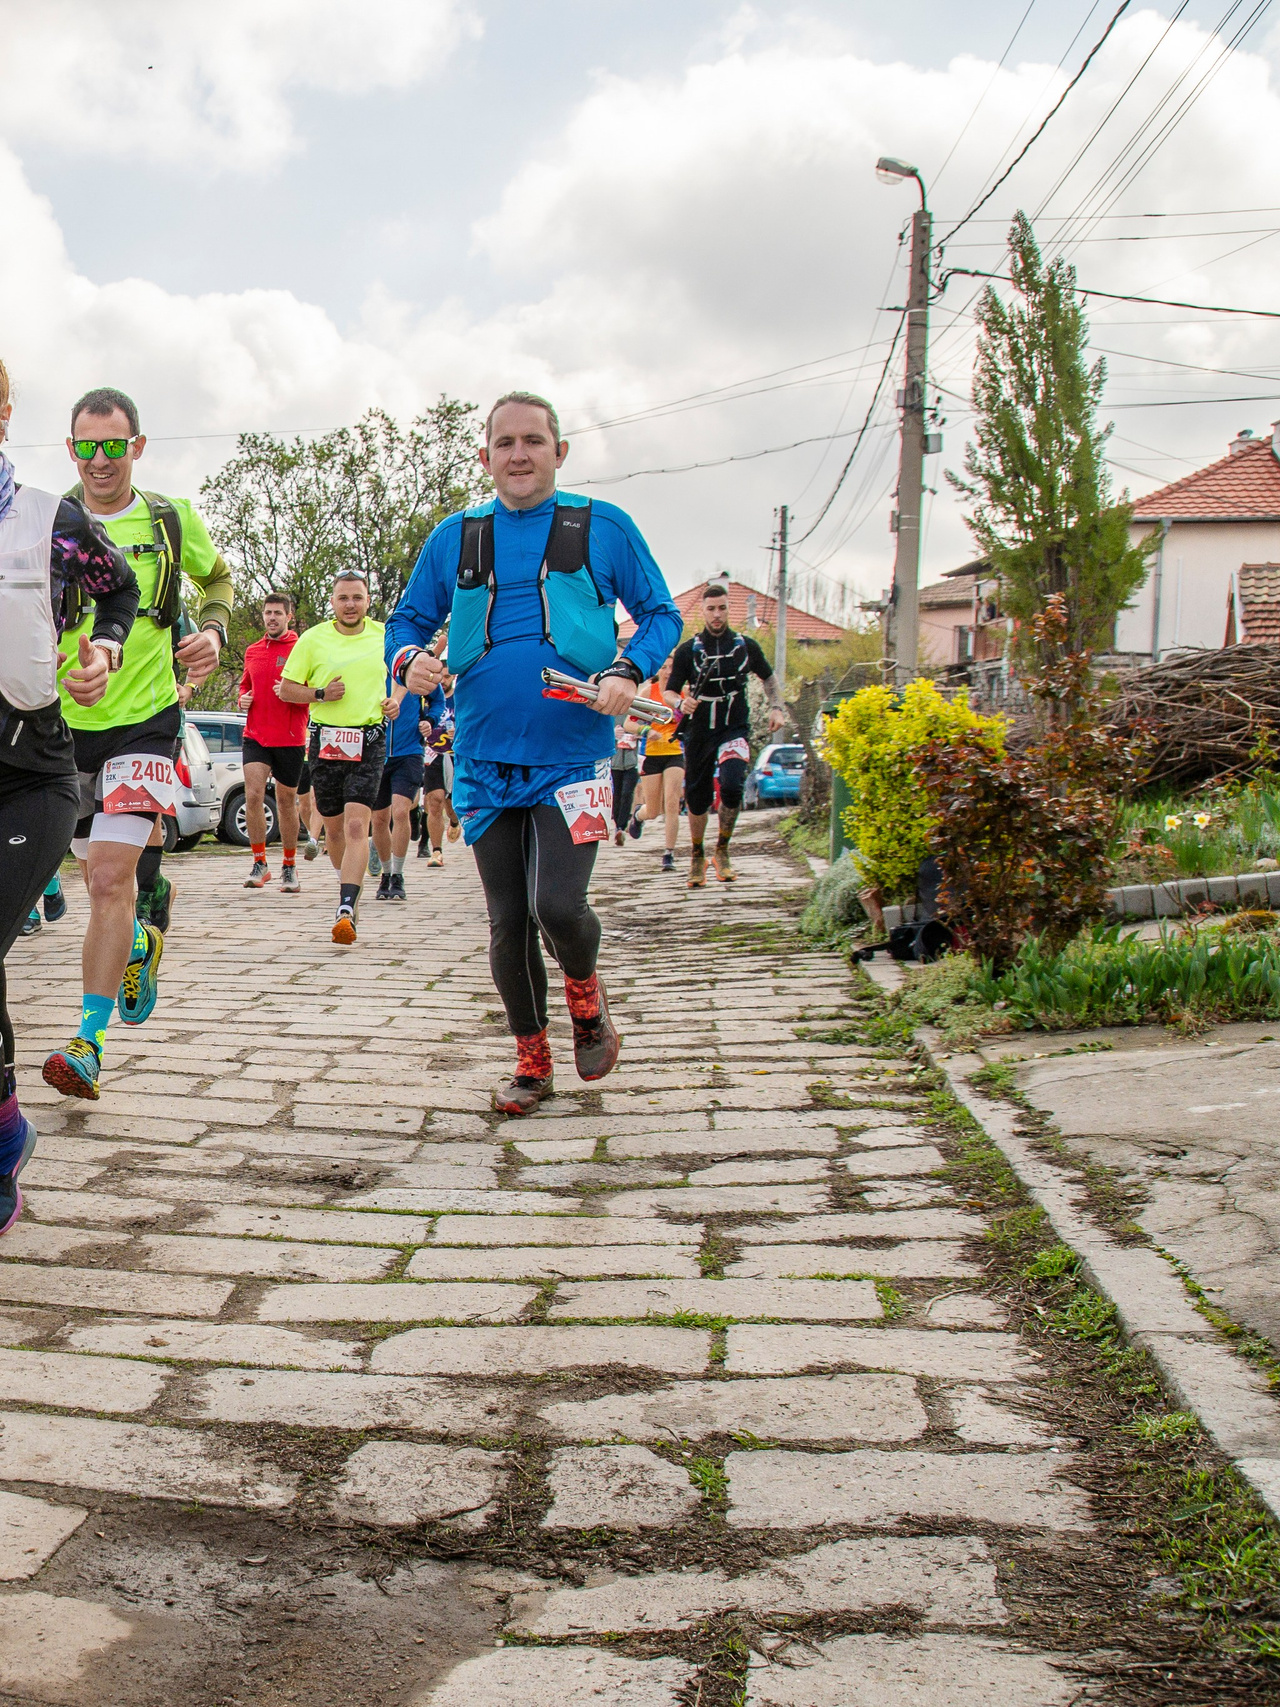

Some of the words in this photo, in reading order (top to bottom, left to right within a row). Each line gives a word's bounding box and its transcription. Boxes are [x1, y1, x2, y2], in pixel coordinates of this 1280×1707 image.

[335, 731, 360, 743] 2106
[105, 773, 117, 781] 22K
[131, 760, 173, 785] 2402
[563, 803, 575, 811] 22K
